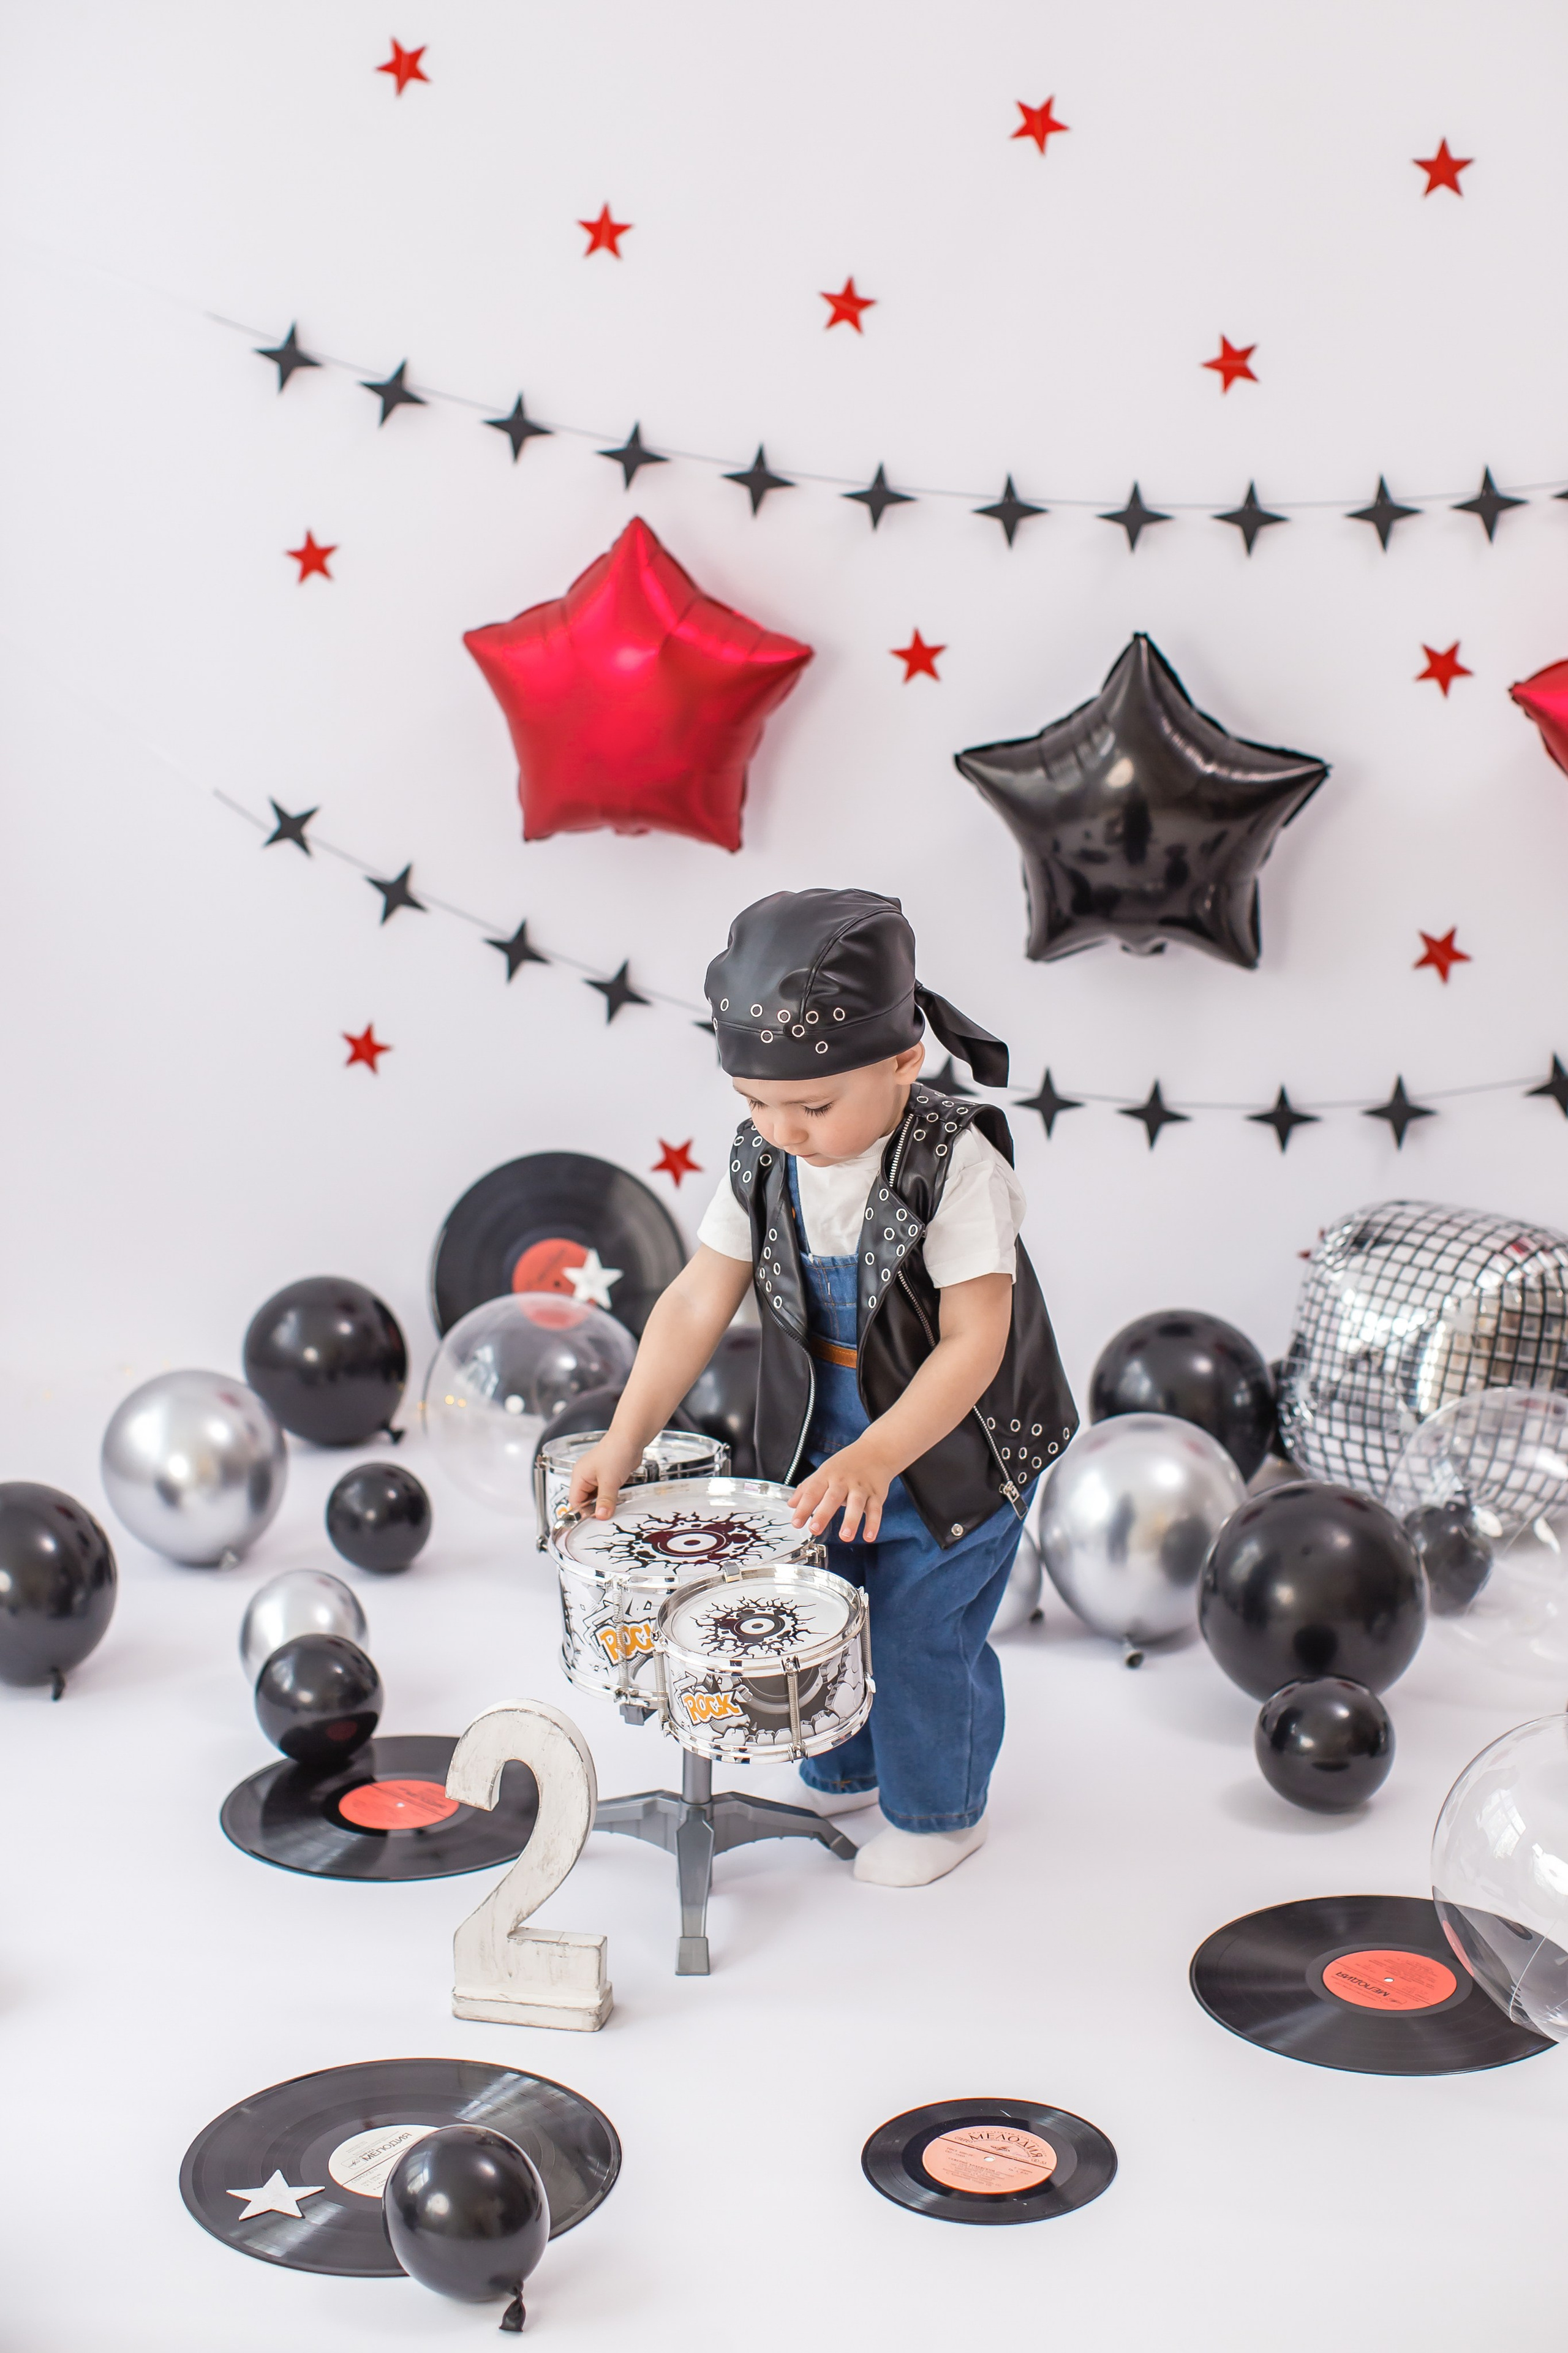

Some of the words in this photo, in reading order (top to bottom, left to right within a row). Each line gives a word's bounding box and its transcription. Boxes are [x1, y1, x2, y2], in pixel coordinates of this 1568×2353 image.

[599, 1623, 655, 1661] ROC
[683, 1693, 741, 1721] ROCK
[445, 1698, 614, 2032] 2
[1335, 1971, 1390, 1997] МЕЛОДИЯ
[362, 2132, 412, 2161] МЕЛОДИЯ
[968, 2132, 1043, 2158] МЕЛОДИЯ
